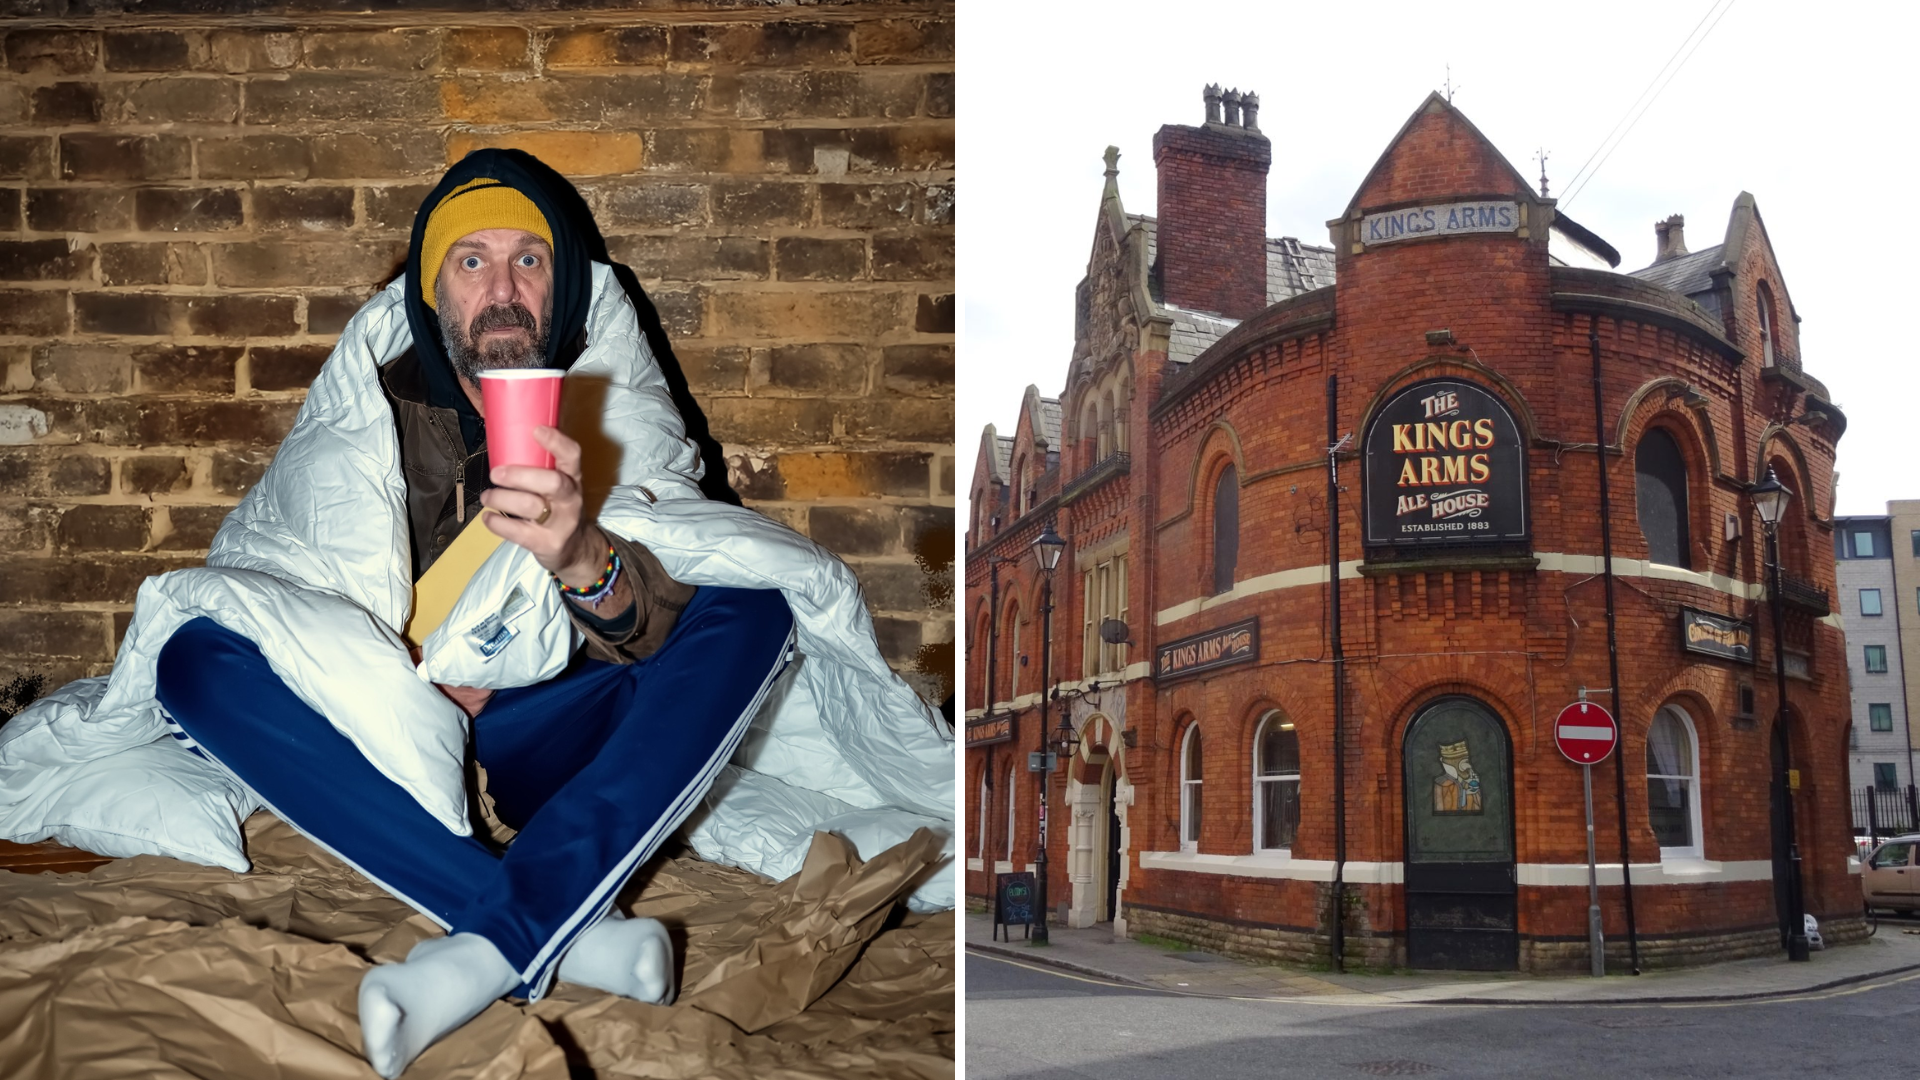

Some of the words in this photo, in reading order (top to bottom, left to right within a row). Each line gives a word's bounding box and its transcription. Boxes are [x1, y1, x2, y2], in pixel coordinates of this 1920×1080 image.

[1446, 205, 1511, 230] ARMS
[1420, 391, 1459, 419] THE
[1392, 418, 1495, 454] KINGS
[1397, 453, 1491, 488] ARMS
[1396, 493, 1428, 516] ALE
[1431, 493, 1490, 519] HOUSE
[1401, 523, 1464, 532] ESTABLISHED
[1467, 521, 1490, 530] 1883
[1172, 644, 1197, 669] KINGS
[1197, 637, 1221, 663] ARMS
[1231, 632, 1251, 653] HOUSE
